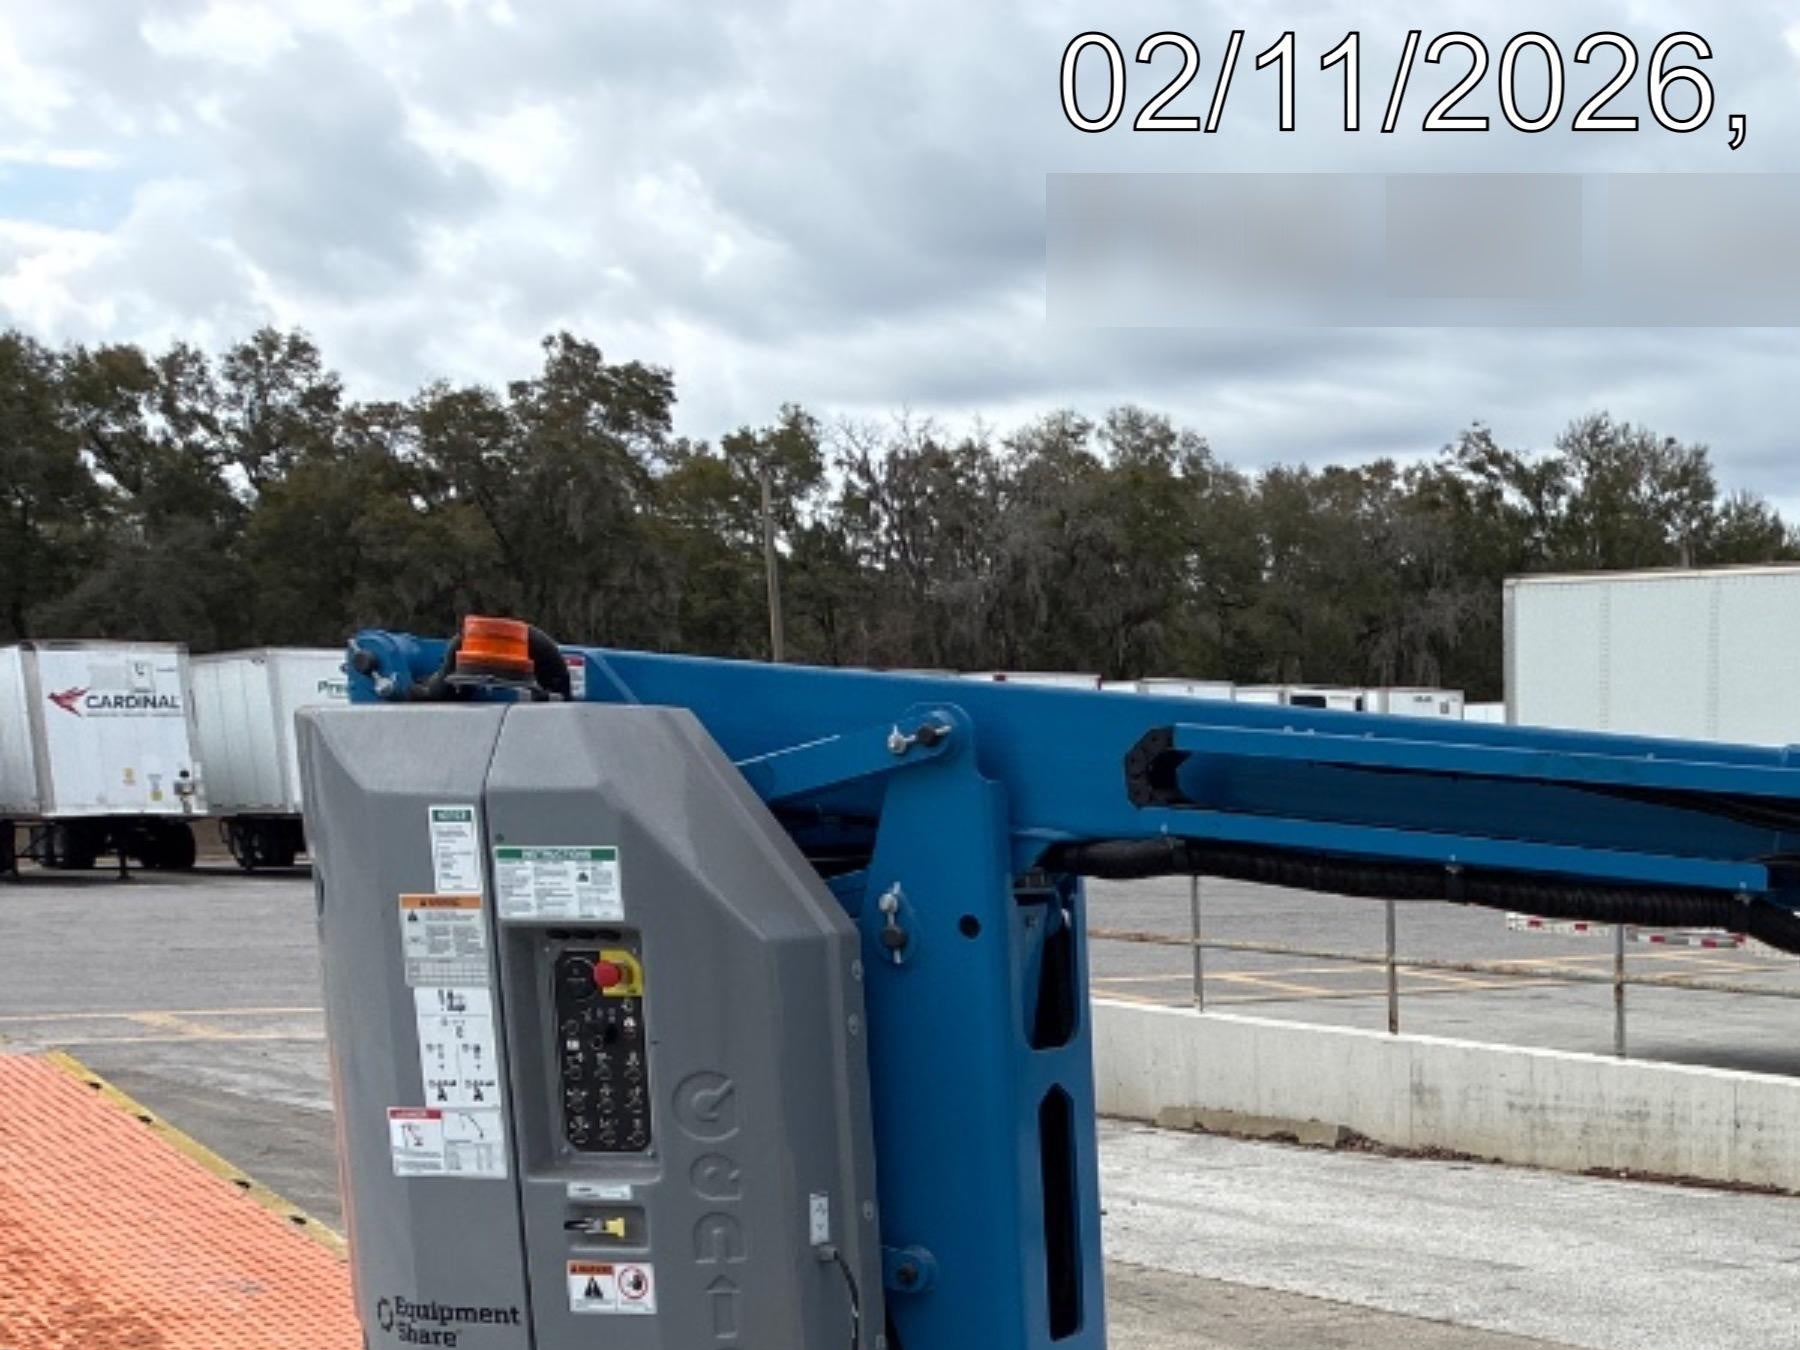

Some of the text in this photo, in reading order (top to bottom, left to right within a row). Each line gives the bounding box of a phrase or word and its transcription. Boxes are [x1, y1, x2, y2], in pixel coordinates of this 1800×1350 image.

[86, 695, 181, 709] CARDINAL
[393, 1295, 521, 1327] Equipment
[396, 1321, 458, 1348] Share
